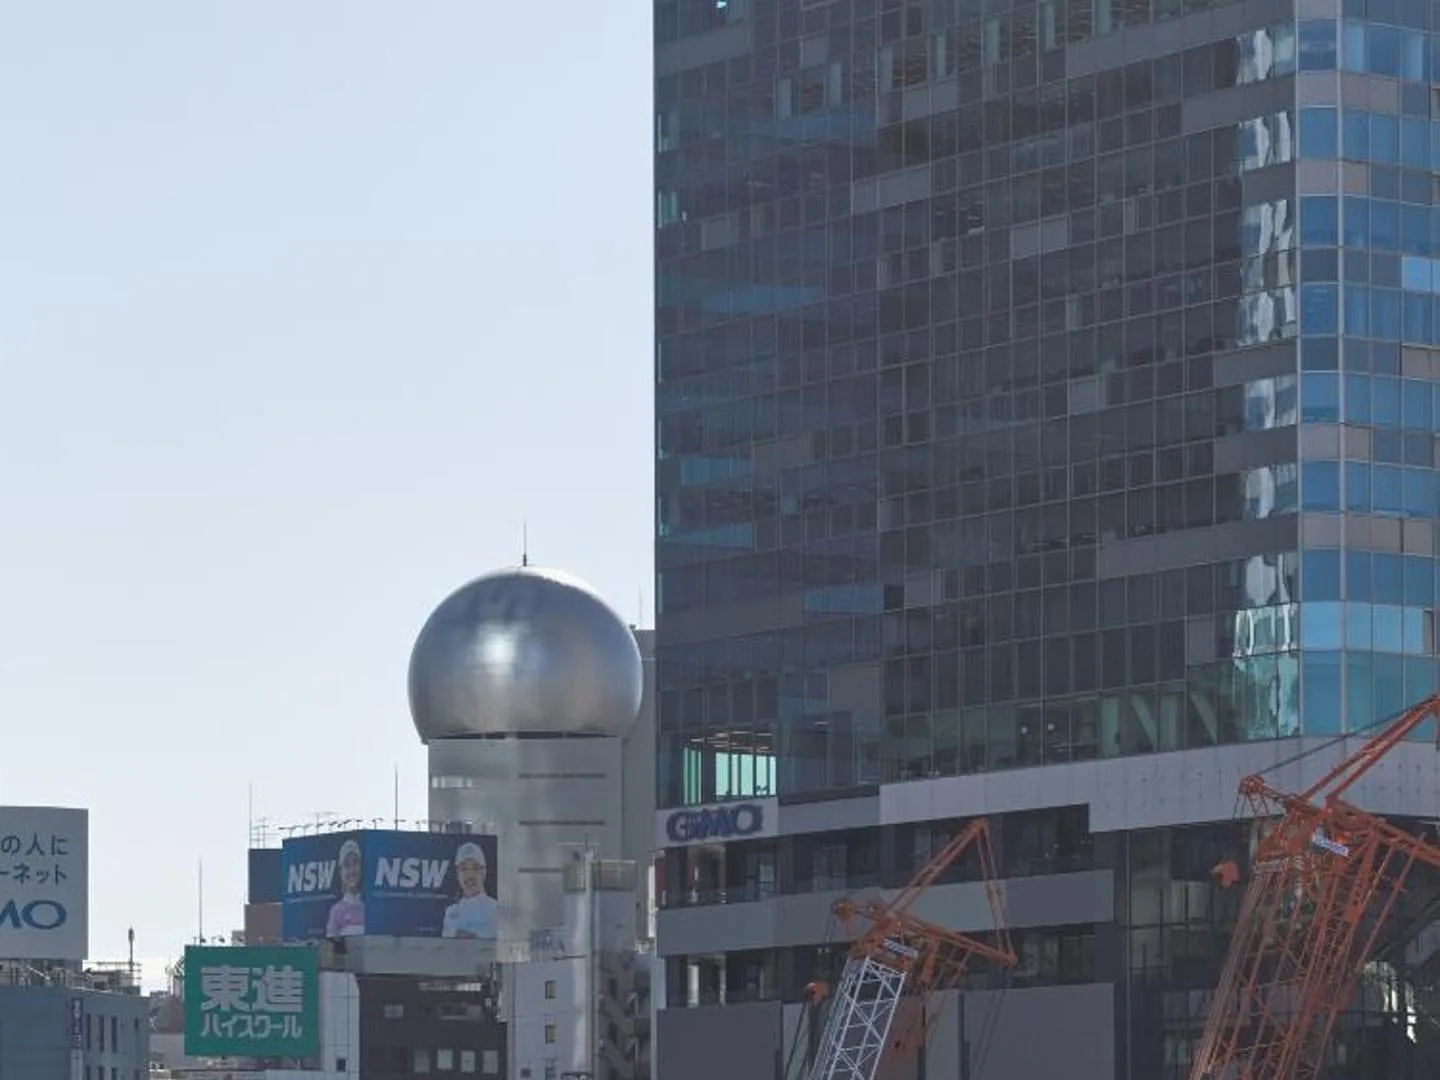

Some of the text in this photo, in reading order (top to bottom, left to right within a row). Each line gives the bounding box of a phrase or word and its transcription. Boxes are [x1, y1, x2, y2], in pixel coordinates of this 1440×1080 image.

[666, 804, 763, 841] GMO
[287, 860, 336, 893] NSW
[374, 857, 450, 888] NSW
[200, 964, 303, 1013] 東進
[200, 1013, 303, 1039] ハイスクール
